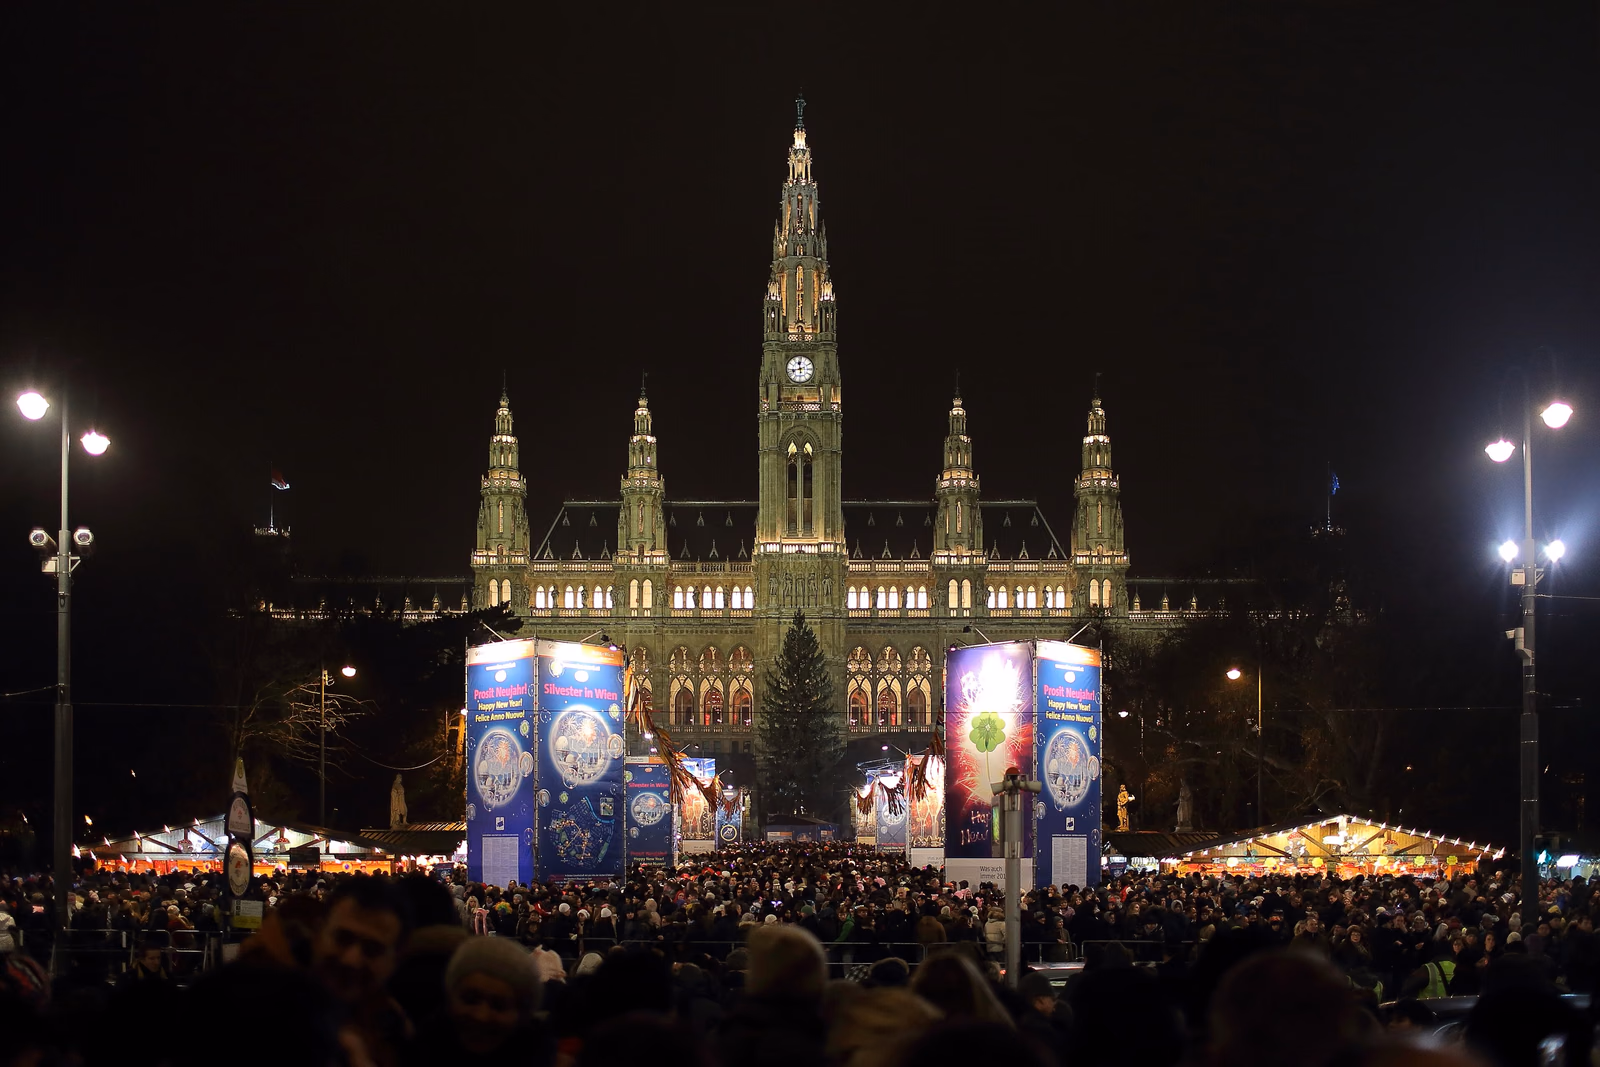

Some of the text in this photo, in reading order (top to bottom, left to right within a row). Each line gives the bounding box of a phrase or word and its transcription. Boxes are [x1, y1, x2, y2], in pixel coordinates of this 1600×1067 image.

[474, 683, 528, 700] Prosit Neujahr!
[543, 683, 618, 700] Silvester in Wien
[1043, 684, 1095, 702] Prosit Neujahr!
[478, 698, 523, 712] Happy New Year!
[1048, 699, 1091, 711] Happy New Year!
[475, 710, 525, 722] Felice Anno Nuovo!
[1046, 711, 1093, 723] Felice Anno Nuovo!
[961, 829, 989, 845] New
